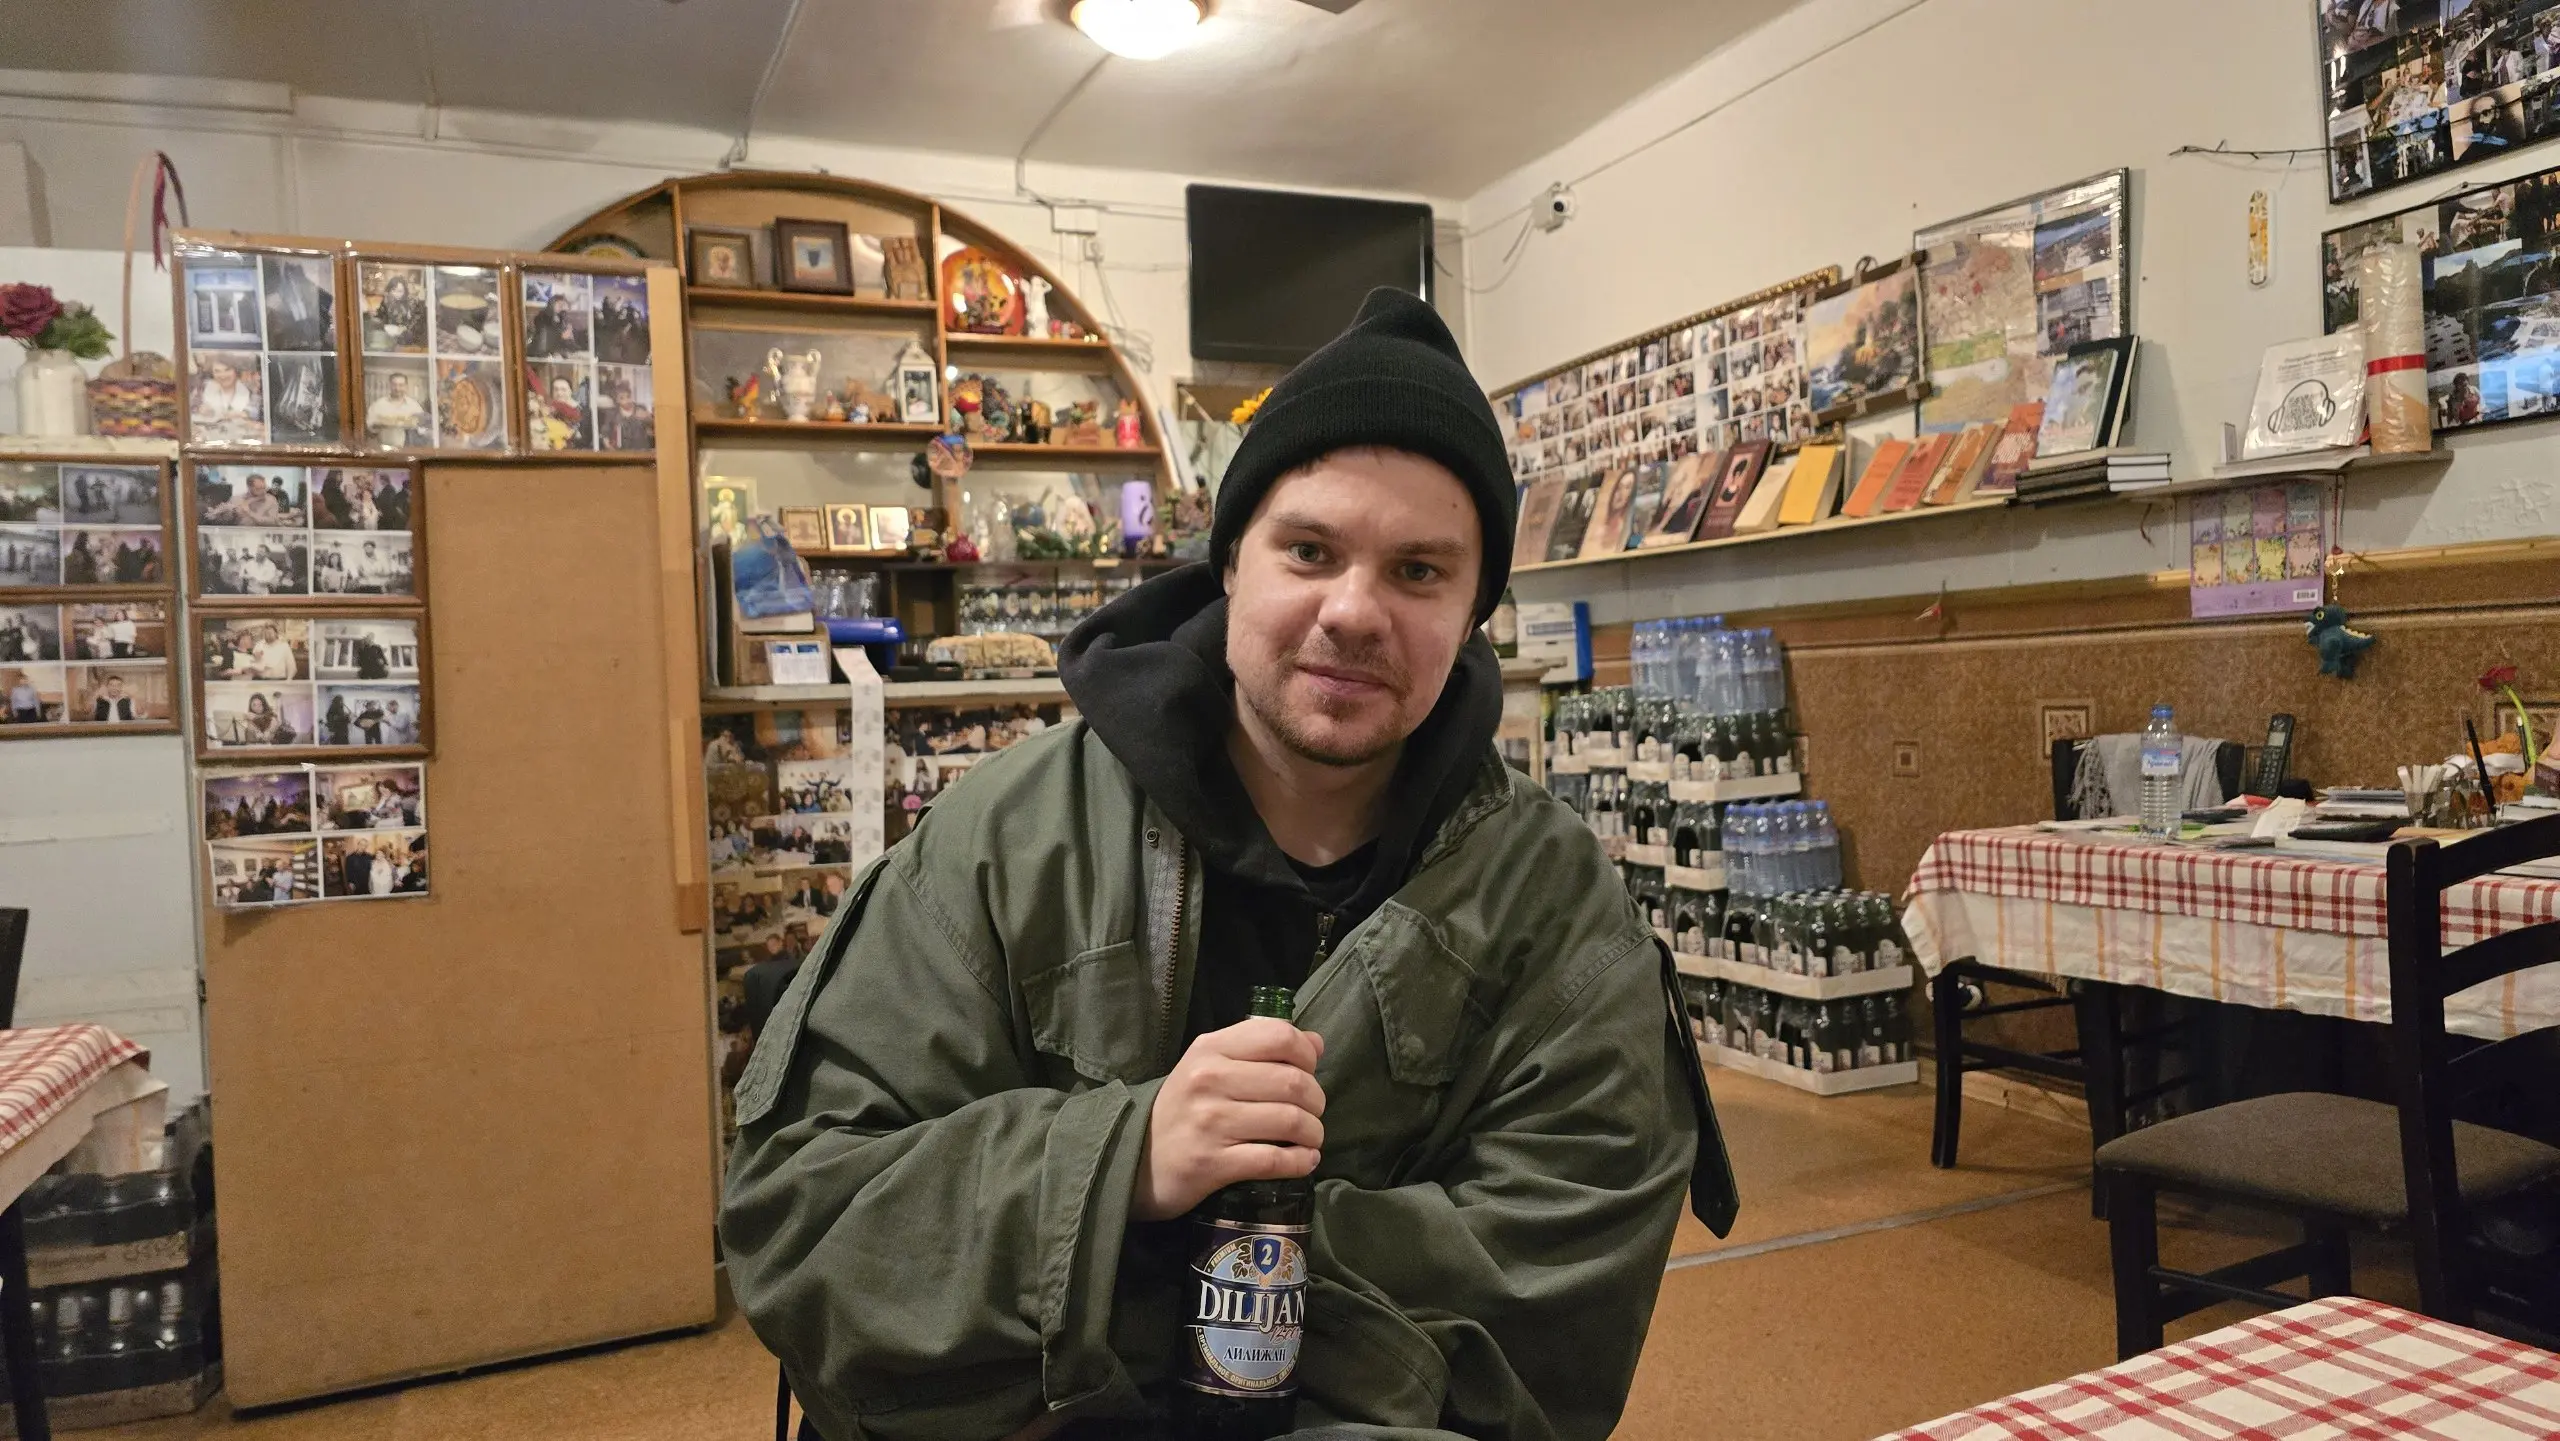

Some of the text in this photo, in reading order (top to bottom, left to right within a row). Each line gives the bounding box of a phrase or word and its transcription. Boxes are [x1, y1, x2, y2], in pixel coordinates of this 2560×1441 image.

[1260, 1243, 1274, 1266] 2
[1197, 1280, 1307, 1333] DILIJAN
[1223, 1346, 1286, 1363] ДИЛИЖАН
